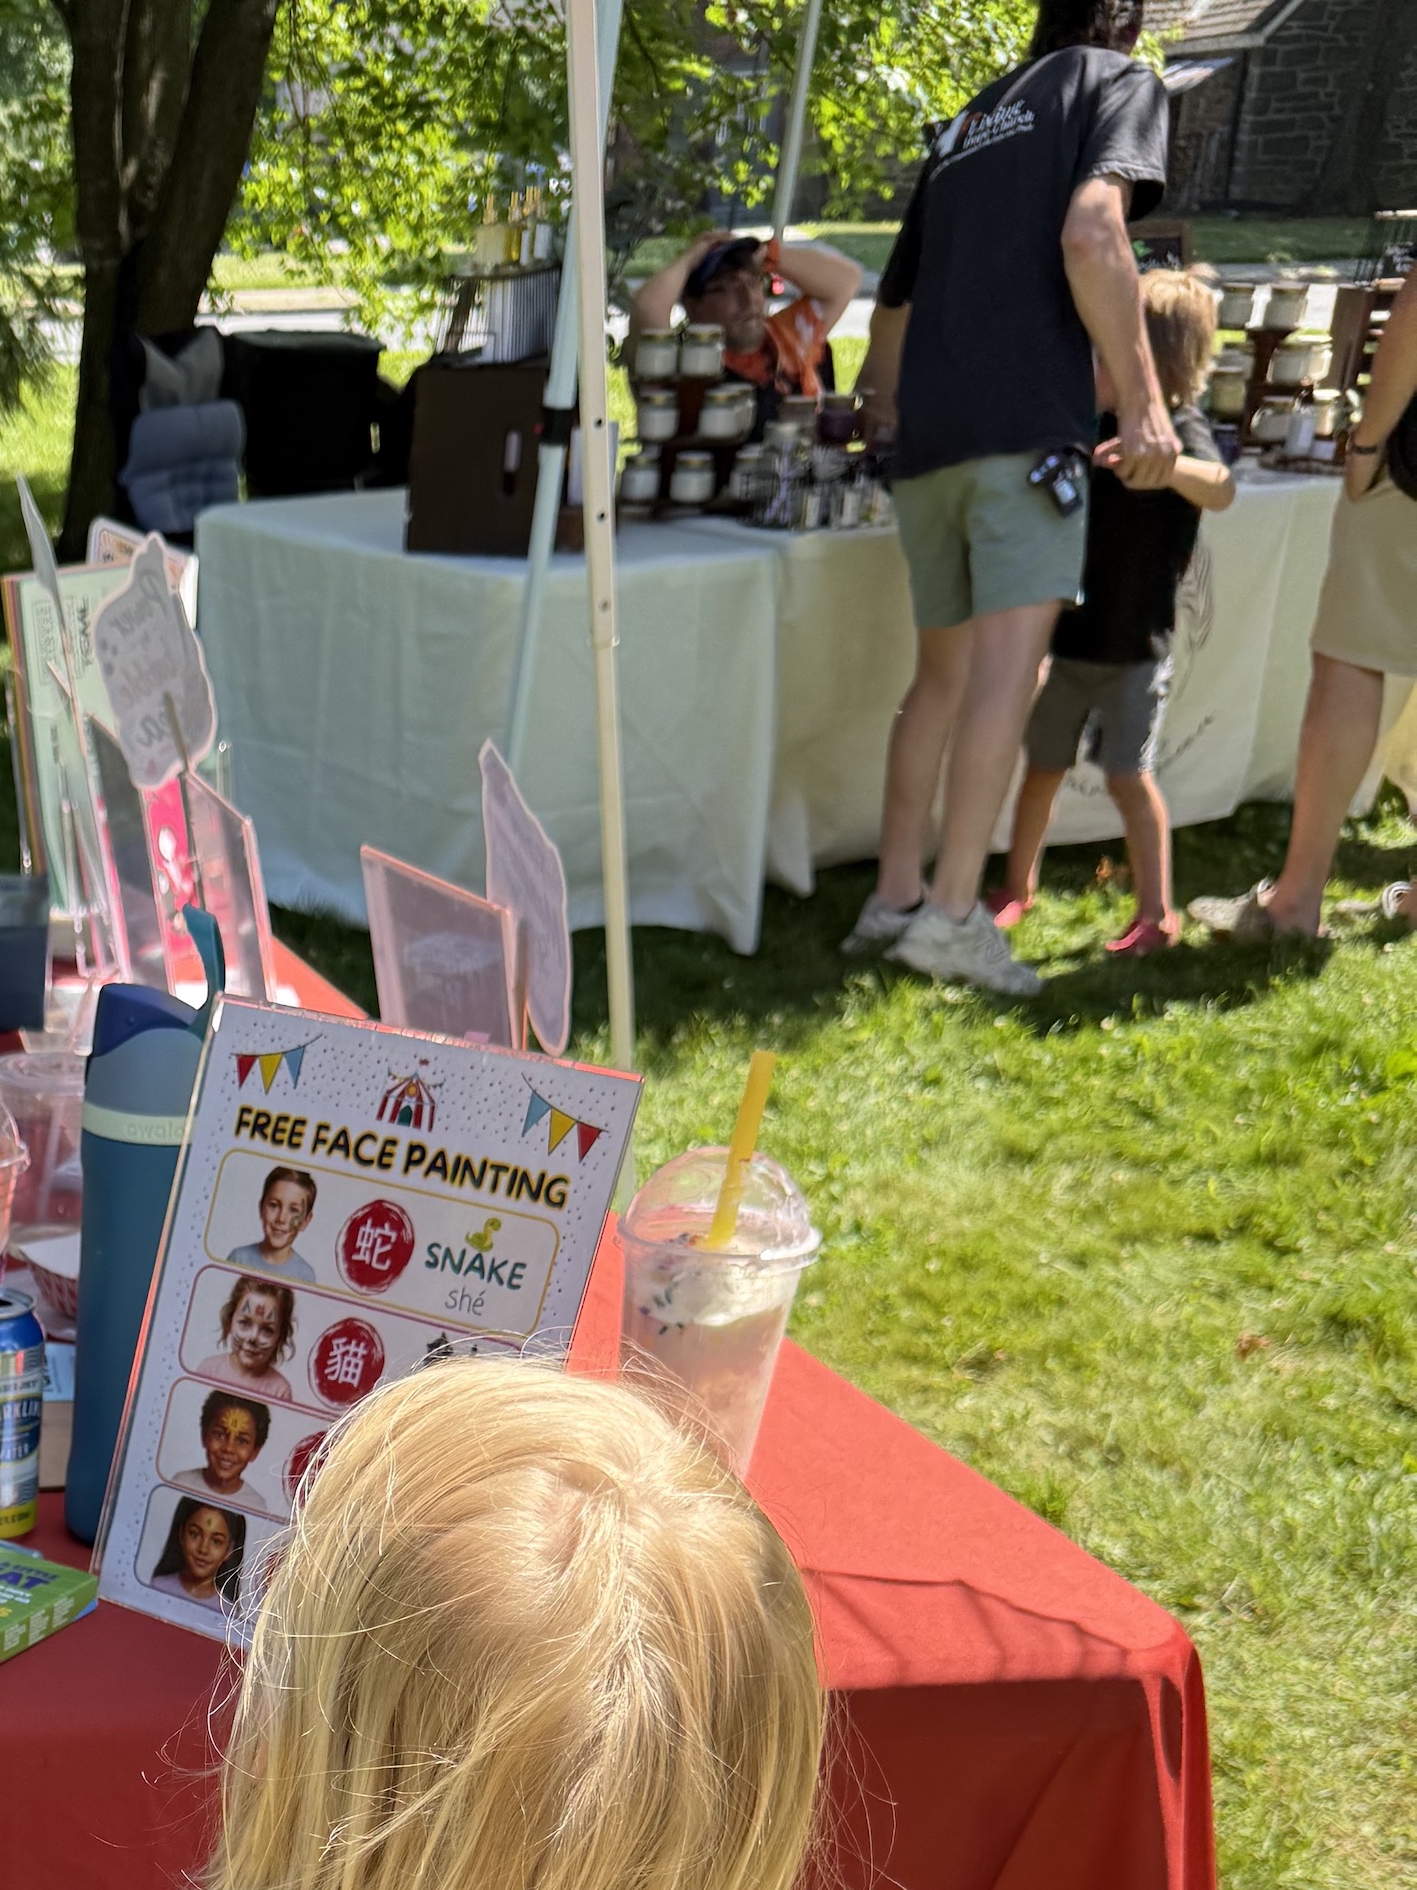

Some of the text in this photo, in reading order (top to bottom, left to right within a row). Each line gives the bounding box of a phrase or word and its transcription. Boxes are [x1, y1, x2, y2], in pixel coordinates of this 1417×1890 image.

[234, 1106, 570, 1209] FREE FACE PAINTING
[351, 1217, 397, 1272] 蛇
[424, 1242, 527, 1290] SNAKE
[445, 1285, 485, 1316] shé
[324, 1336, 368, 1389] 貓
